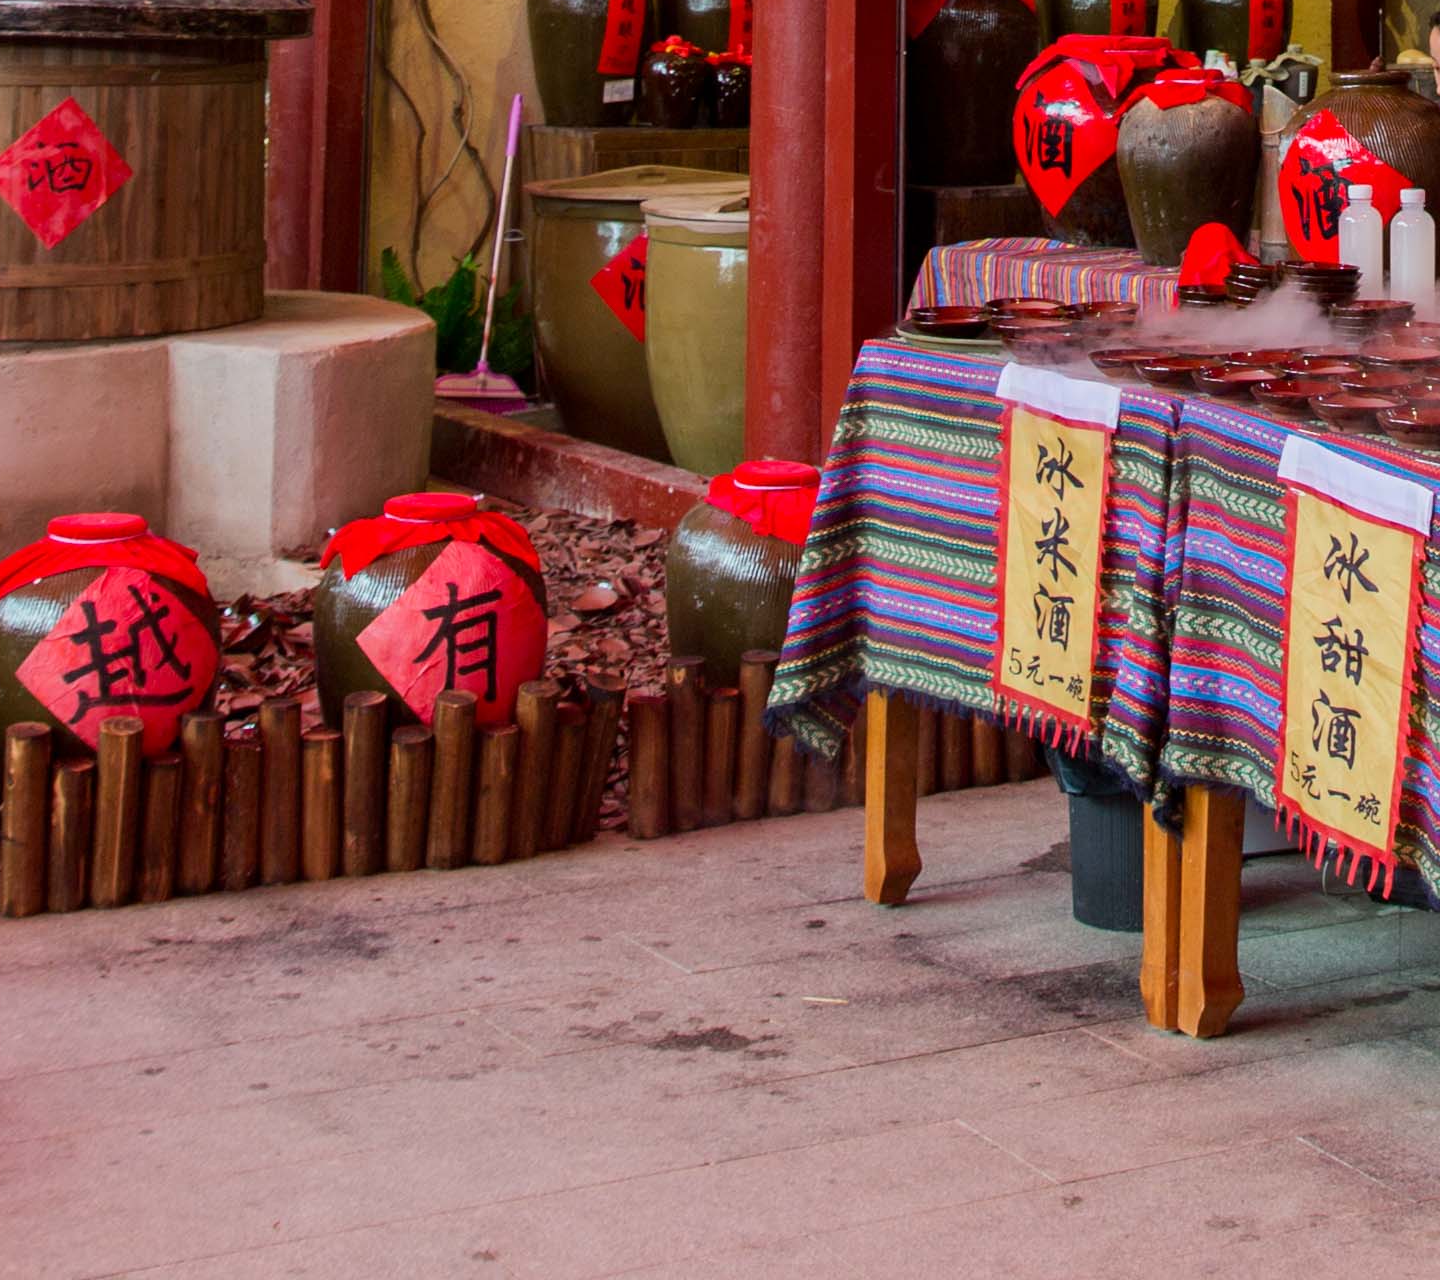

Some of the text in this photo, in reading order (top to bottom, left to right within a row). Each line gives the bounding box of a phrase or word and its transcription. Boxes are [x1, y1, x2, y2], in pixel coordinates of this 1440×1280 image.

[27, 141, 93, 194] 酒
[1021, 92, 1073, 180] 酒
[1291, 155, 1352, 241] 酒
[1033, 436, 1084, 654] 冰米酒
[60, 584, 195, 727] 越
[412, 581, 504, 705] 有
[1008, 645, 1086, 705] 5元一碗
[1311, 530, 1380, 771] 冰甜酒
[1290, 749, 1383, 827] 5元一碗
